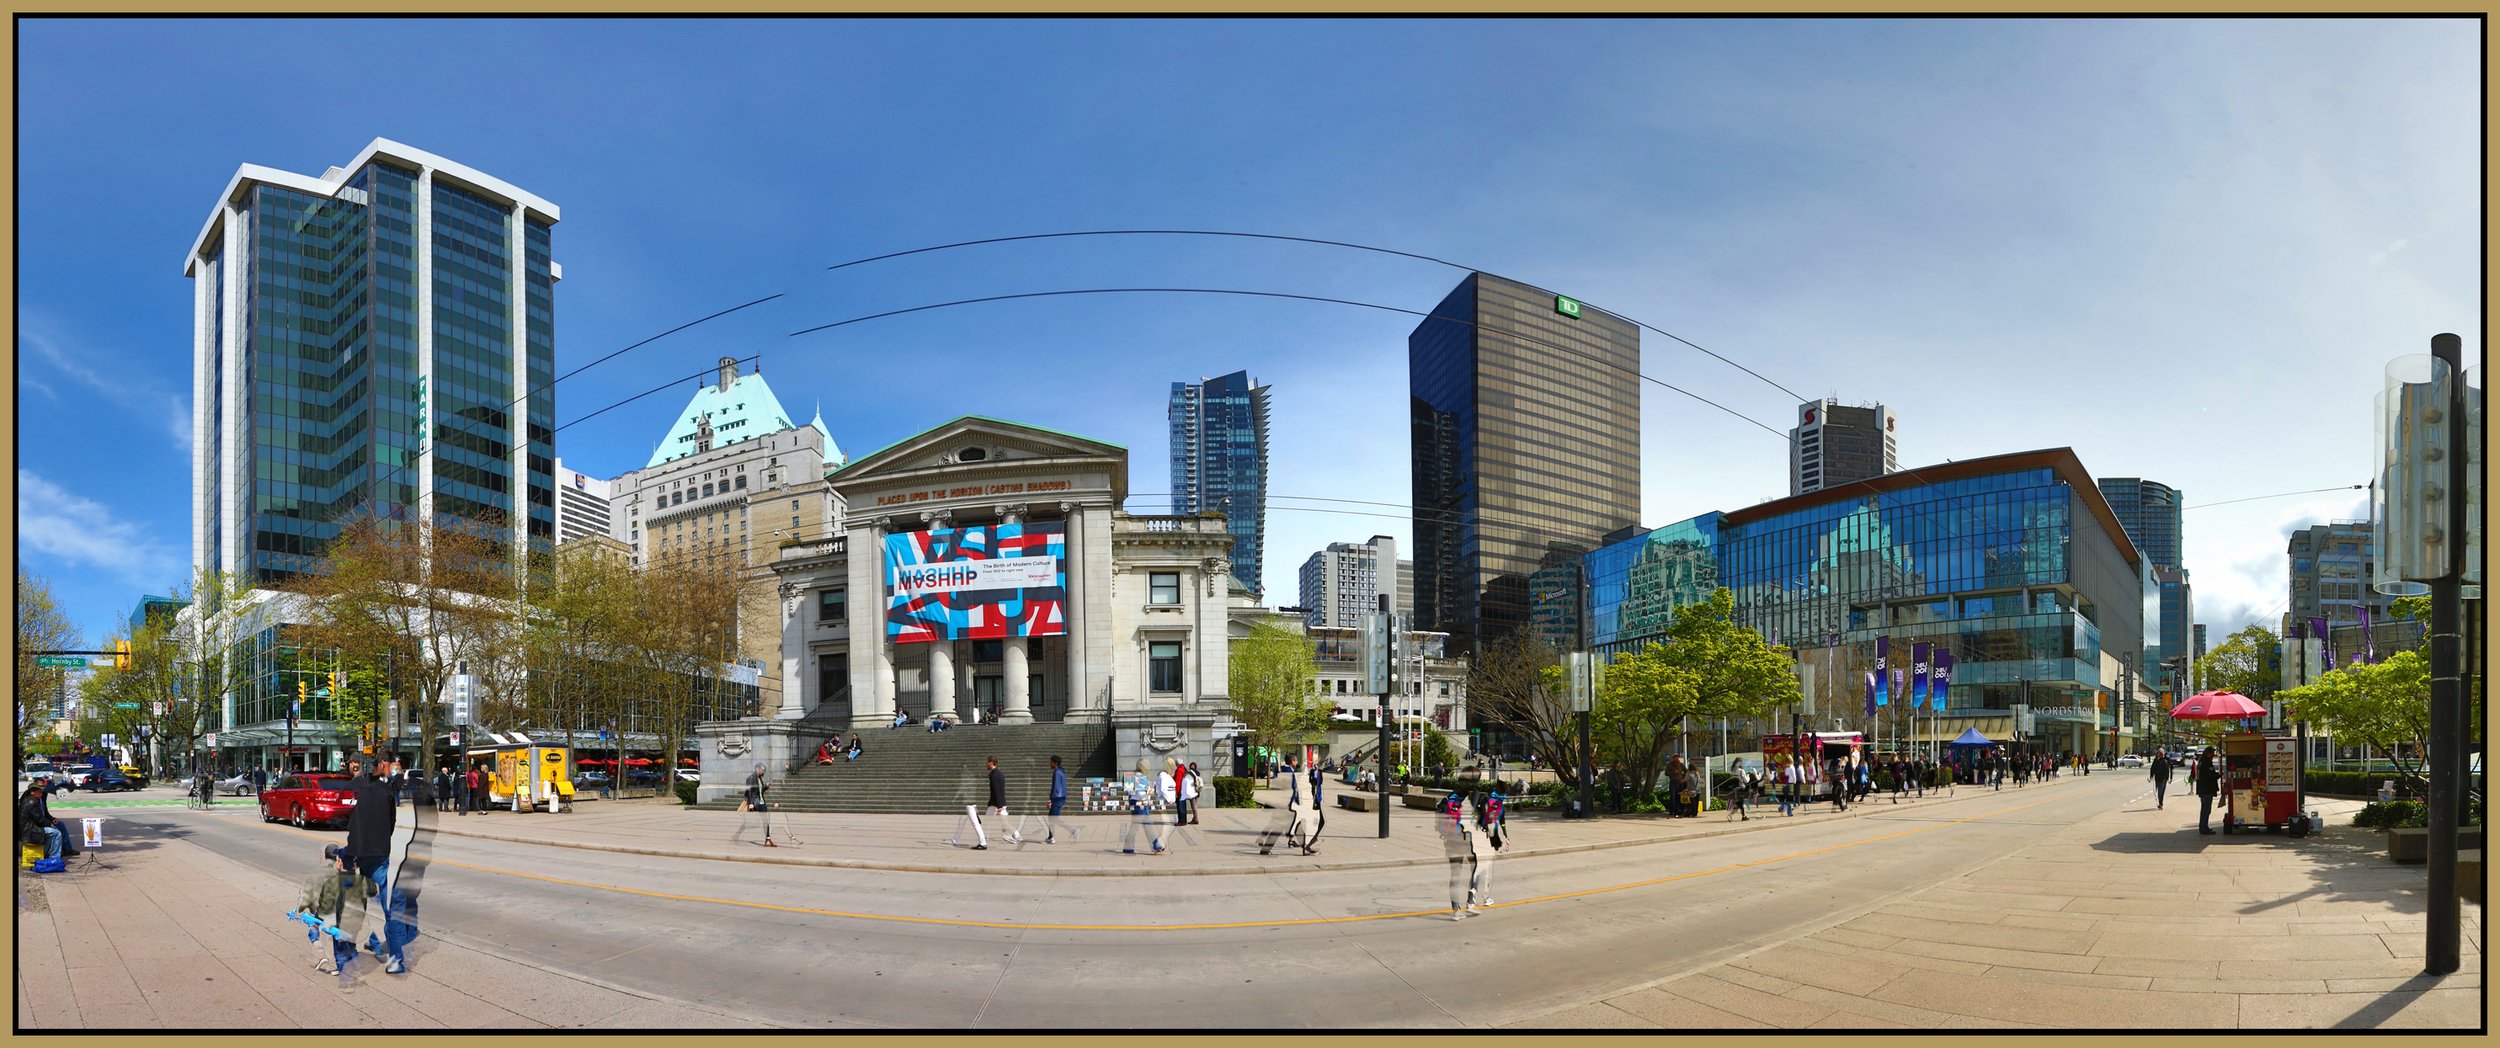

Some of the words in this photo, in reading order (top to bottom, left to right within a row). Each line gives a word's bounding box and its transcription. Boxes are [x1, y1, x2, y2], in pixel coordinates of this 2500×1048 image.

[1560, 298, 1579, 313] TD
[877, 494, 906, 506] PLACED
[909, 491, 929, 502] UPON
[932, 489, 947, 499] THE
[950, 486, 983, 498] HORIZON
[51, 658, 72, 666] Hornby
[2124, 654, 2132, 724] NORDSTROM
[2033, 705, 2094, 717] NORDSTROM
